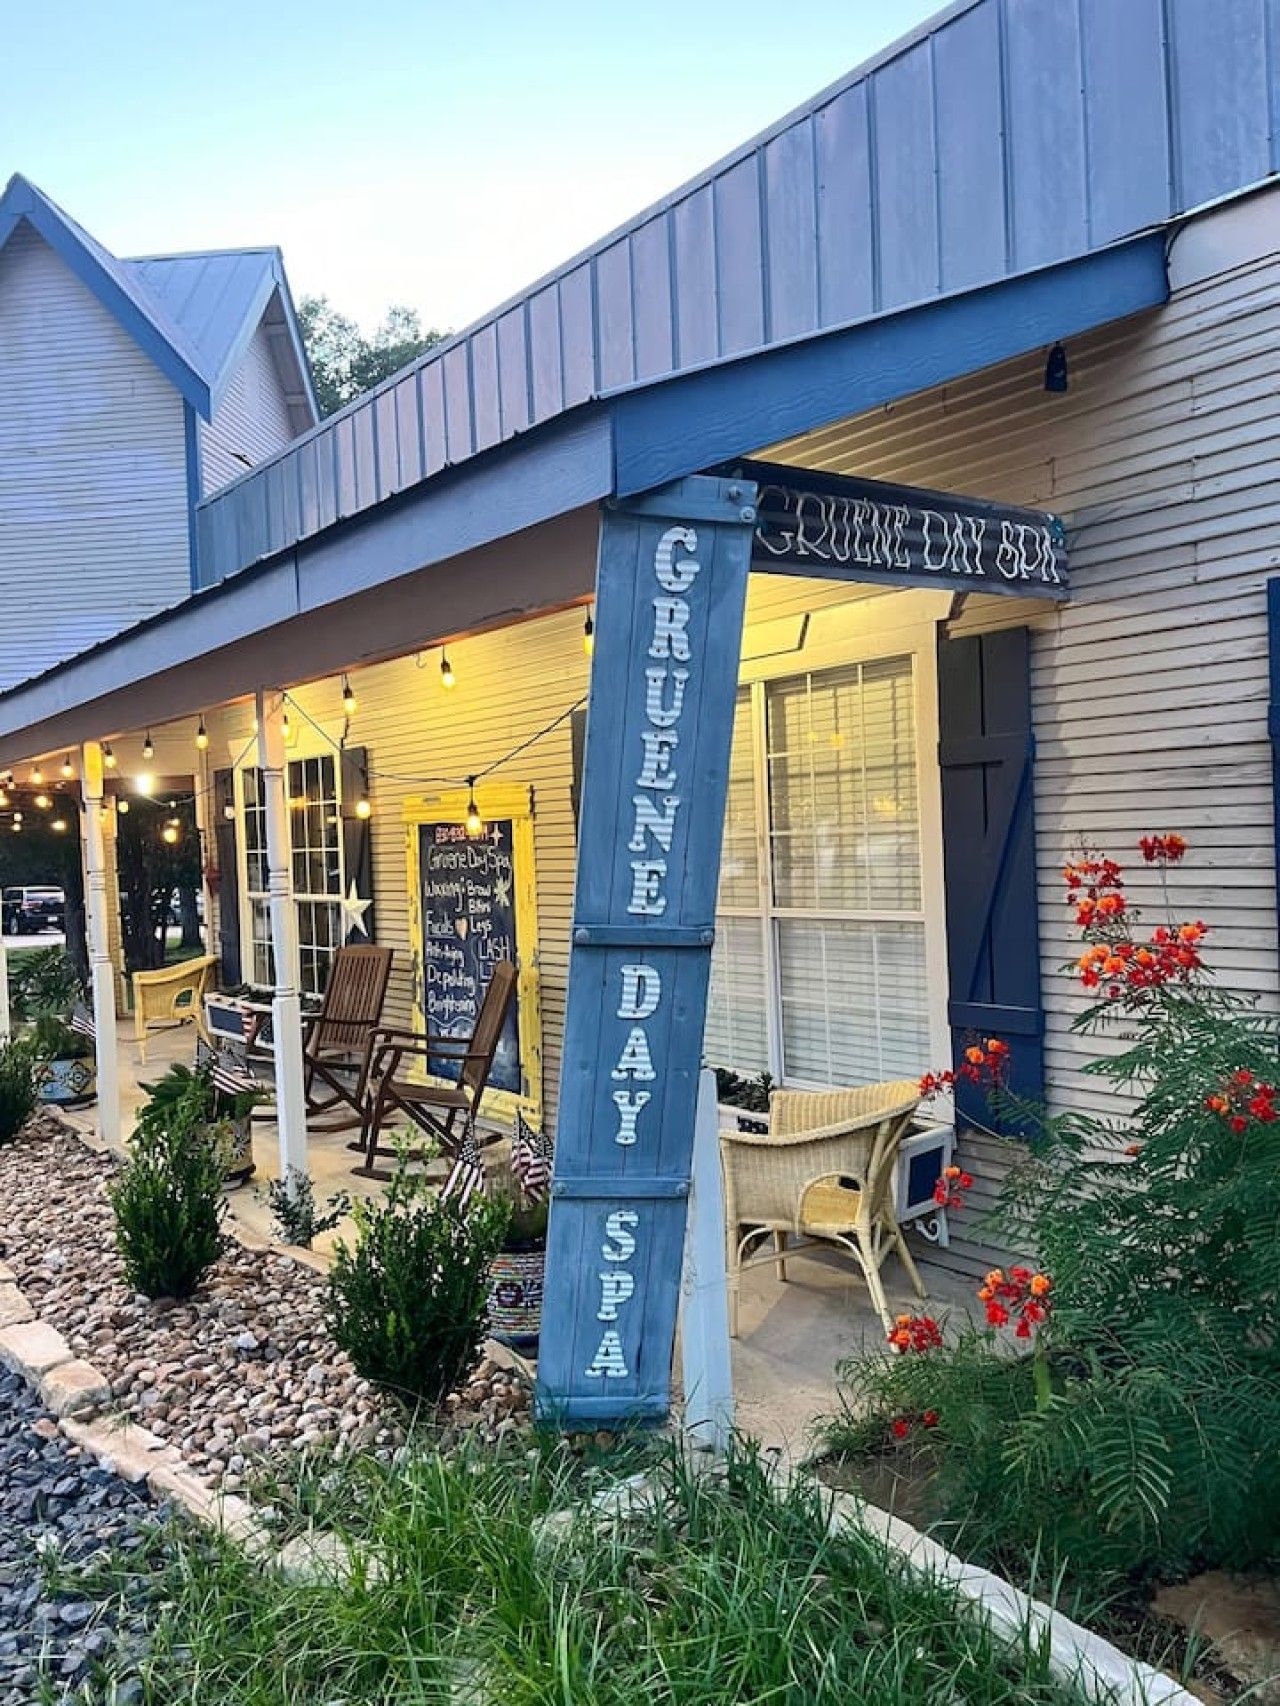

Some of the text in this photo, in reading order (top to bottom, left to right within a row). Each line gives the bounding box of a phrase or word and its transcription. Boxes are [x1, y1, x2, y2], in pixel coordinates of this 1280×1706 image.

[756, 485, 1060, 583] GRUENE DAY SPA
[585, 525, 700, 1379] GRUENE DAY SPA
